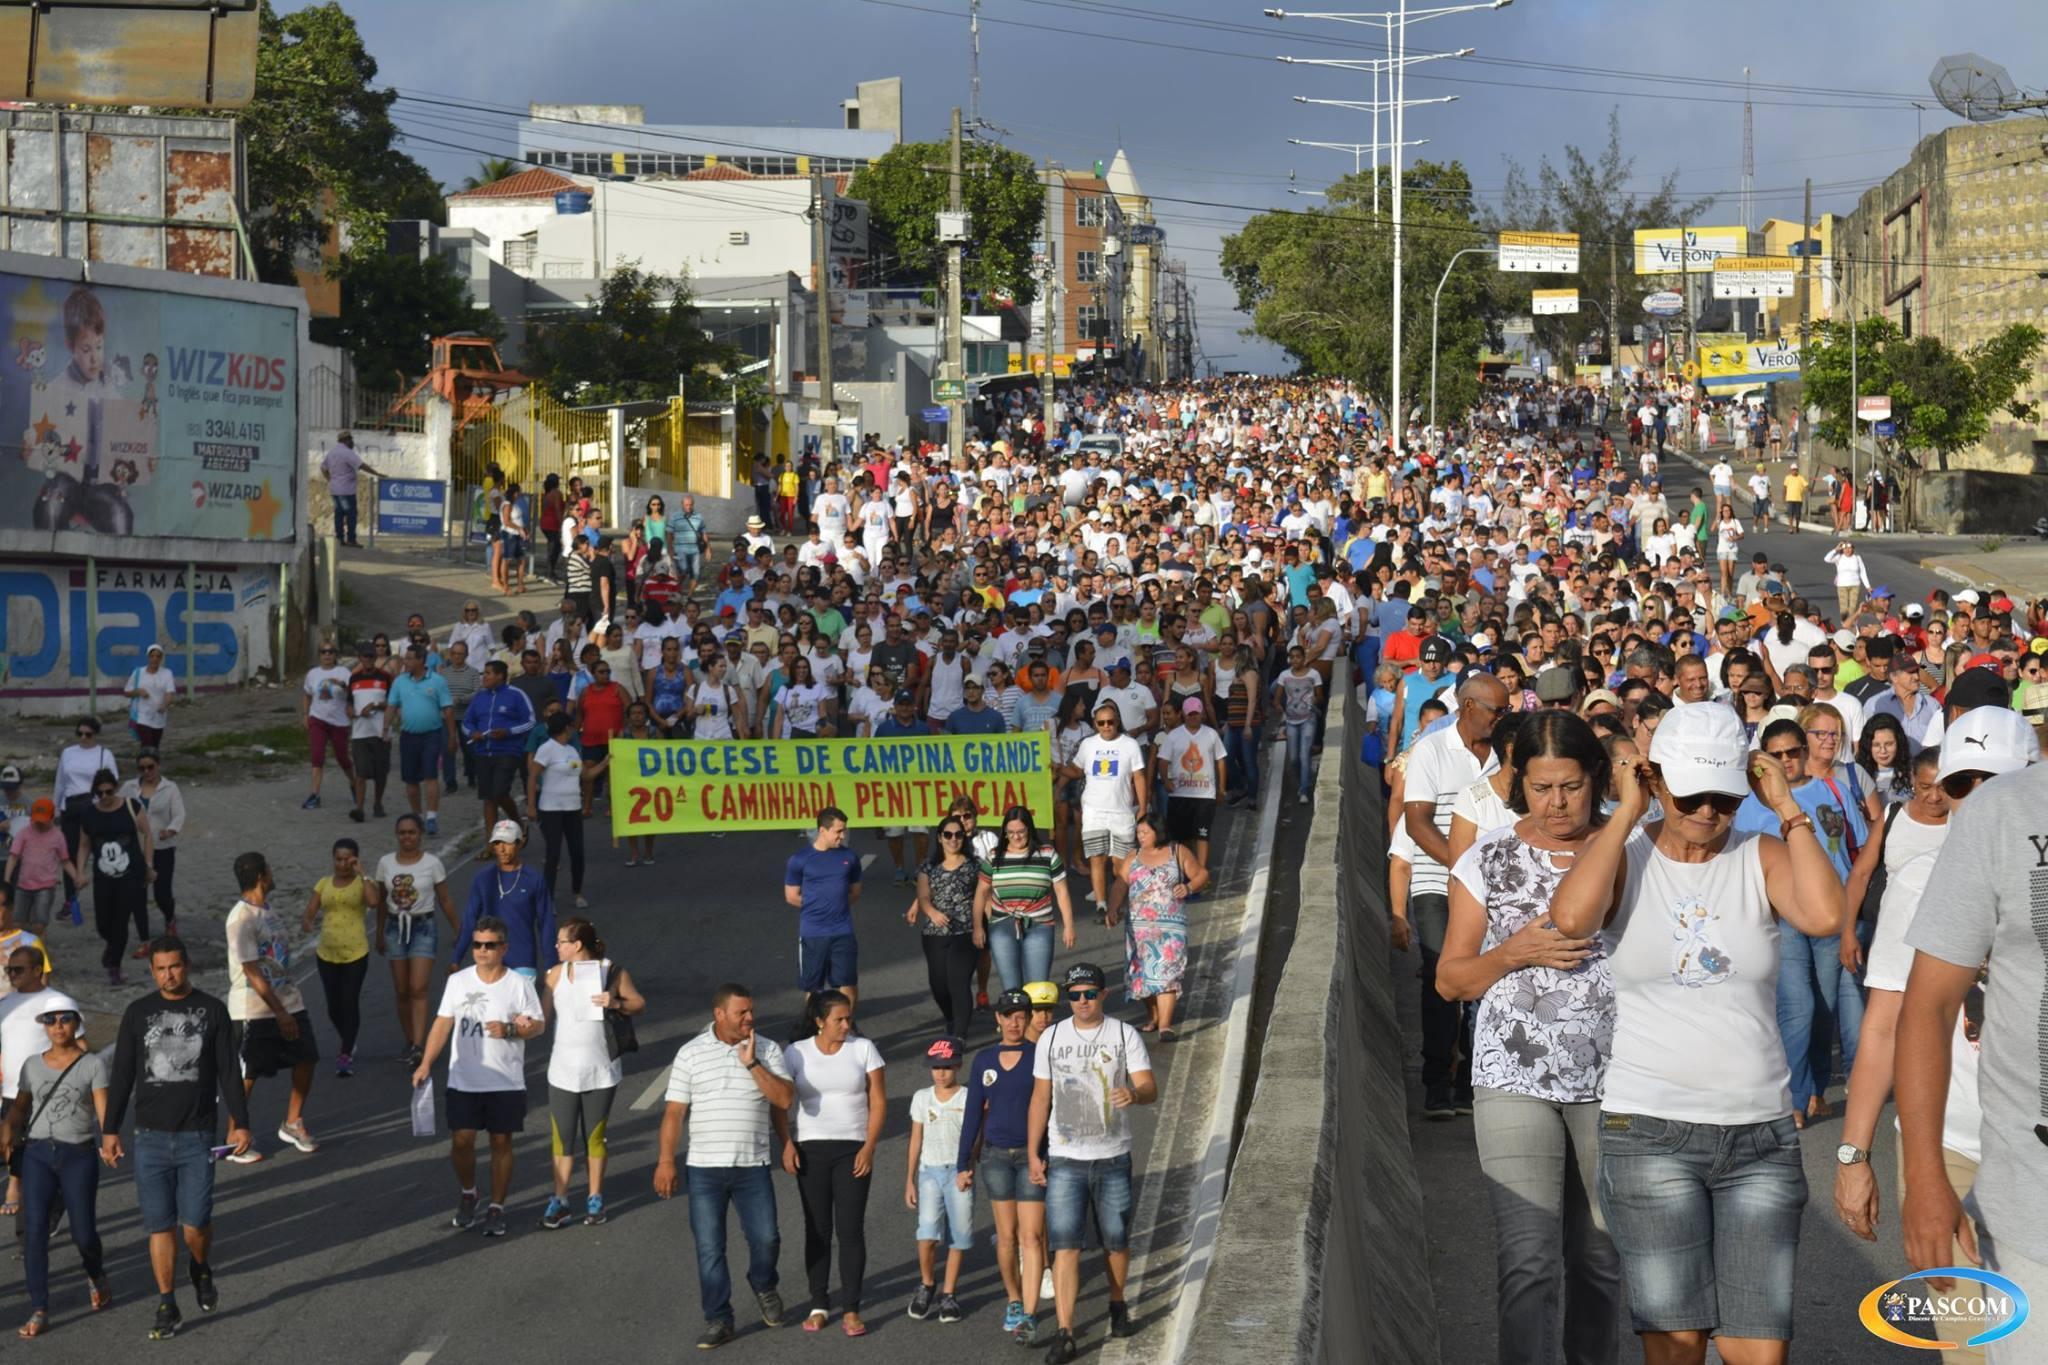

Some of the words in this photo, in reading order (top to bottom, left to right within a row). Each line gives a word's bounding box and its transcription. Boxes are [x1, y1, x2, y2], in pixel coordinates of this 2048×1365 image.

[207, 482, 263, 501] WIZARD
[637, 745, 780, 777] DIOCESE
[795, 744, 832, 775] DE
[843, 742, 956, 774] CAMPINA
[963, 740, 1042, 773] GRANDE
[701, 780, 837, 821] CAMINHADA
[854, 779, 1036, 819] PENITENCIAL
